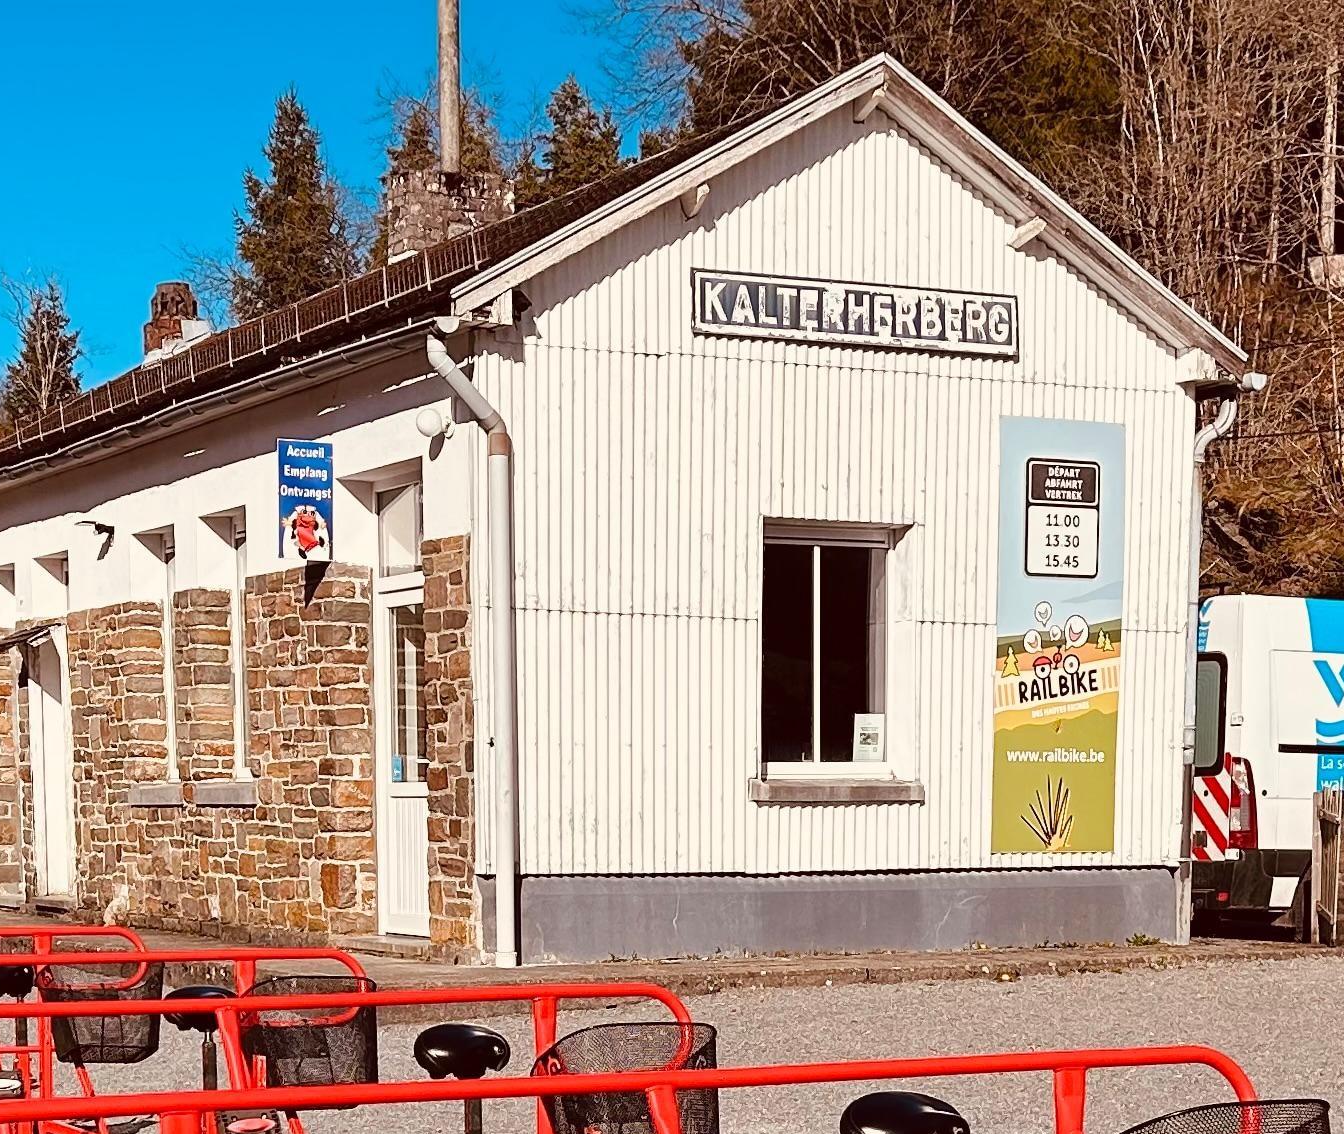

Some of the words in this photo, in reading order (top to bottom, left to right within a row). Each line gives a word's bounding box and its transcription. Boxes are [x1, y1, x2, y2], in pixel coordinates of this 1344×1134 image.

[703, 280, 1010, 343] KALTERHERBERG
[286, 444, 325, 459] Accueil
[283, 464, 328, 481] Empfang
[1048, 466, 1081, 478] DÉPART
[1044, 478, 1084, 490] ABFAHRT
[280, 484, 332, 500] Ontvangst
[1044, 489, 1083, 500] VERTREK
[1045, 513, 1080, 528] 11.00
[1045, 533, 1080, 548] 13.30
[1044, 554, 1080, 568] 15.45
[1018, 669, 1099, 704] RAILBIKE
[1006, 747, 1105, 763] www.railbike.be
[1321, 755, 1334, 769] La
